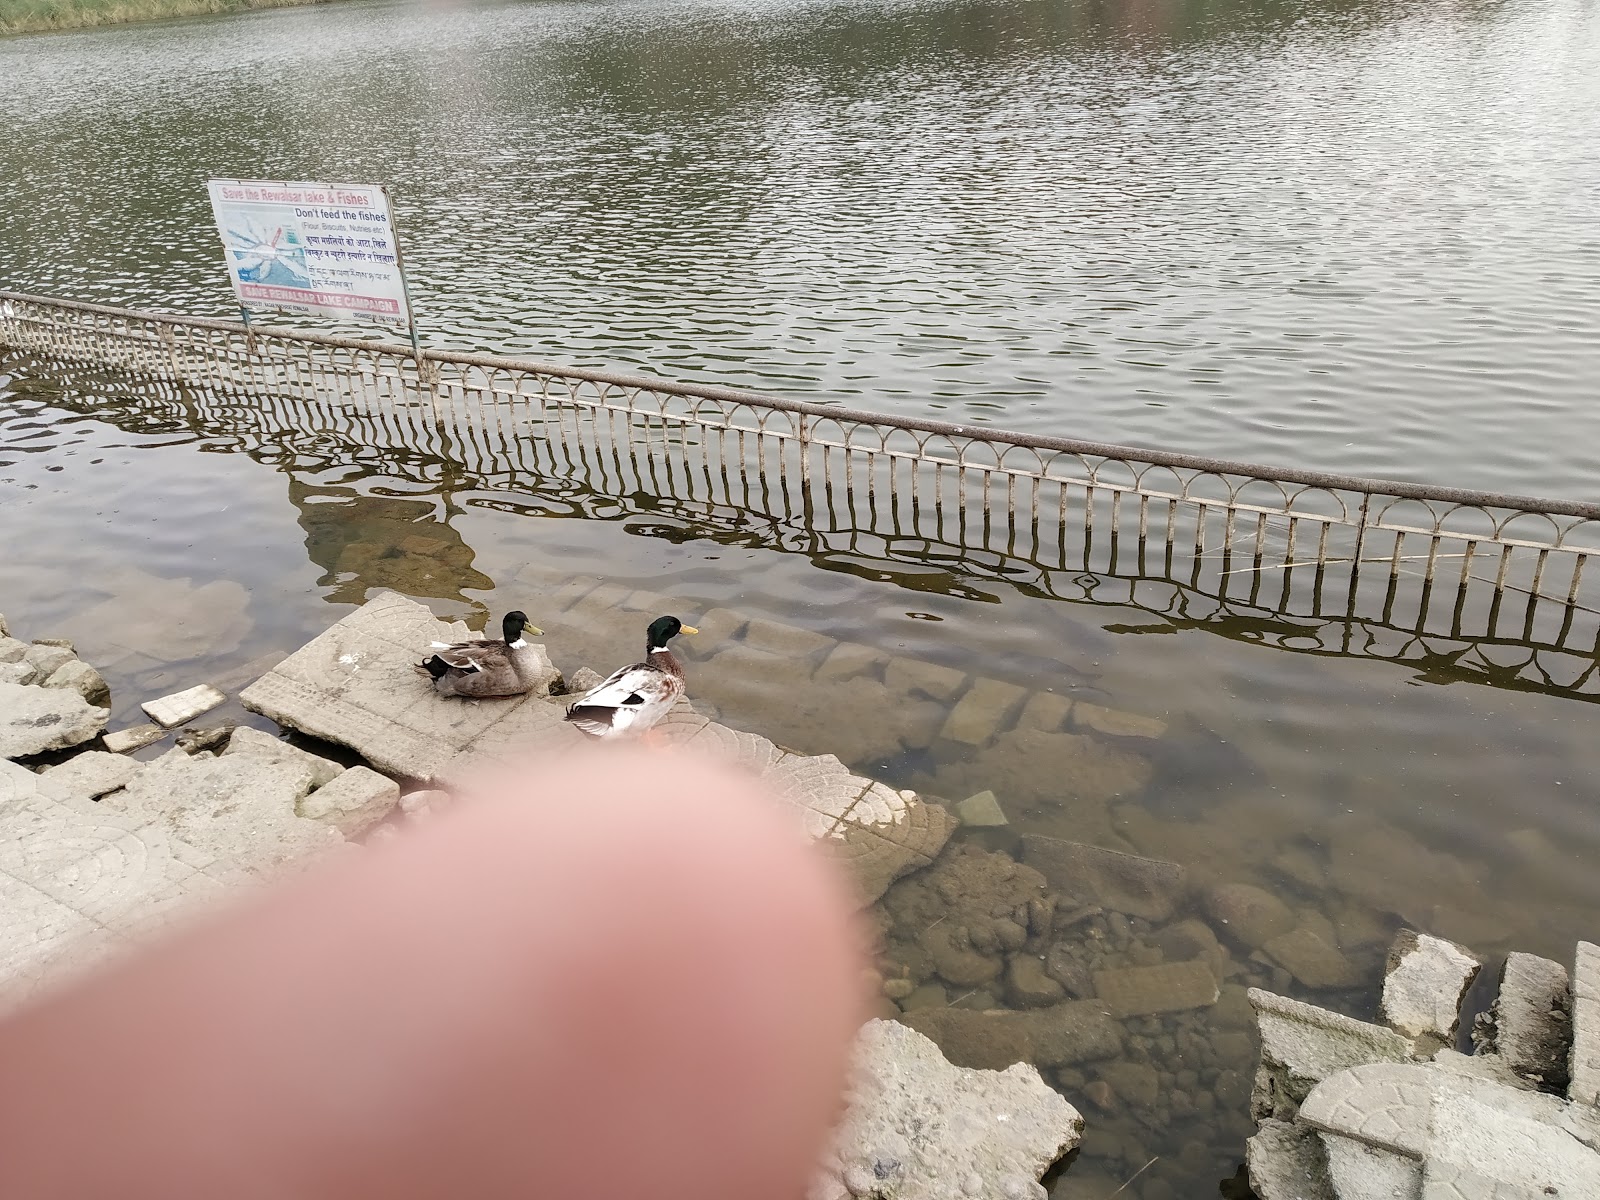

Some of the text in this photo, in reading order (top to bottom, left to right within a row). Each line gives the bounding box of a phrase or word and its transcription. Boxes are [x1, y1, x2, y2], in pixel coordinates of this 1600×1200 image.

[222, 186, 369, 205] Save the Rewalsar lake & Fishes
[295, 208, 387, 222] Don't feed the fishes
[245, 286, 394, 312] SAVE REWALSAR LAKE CAMPAIGN
